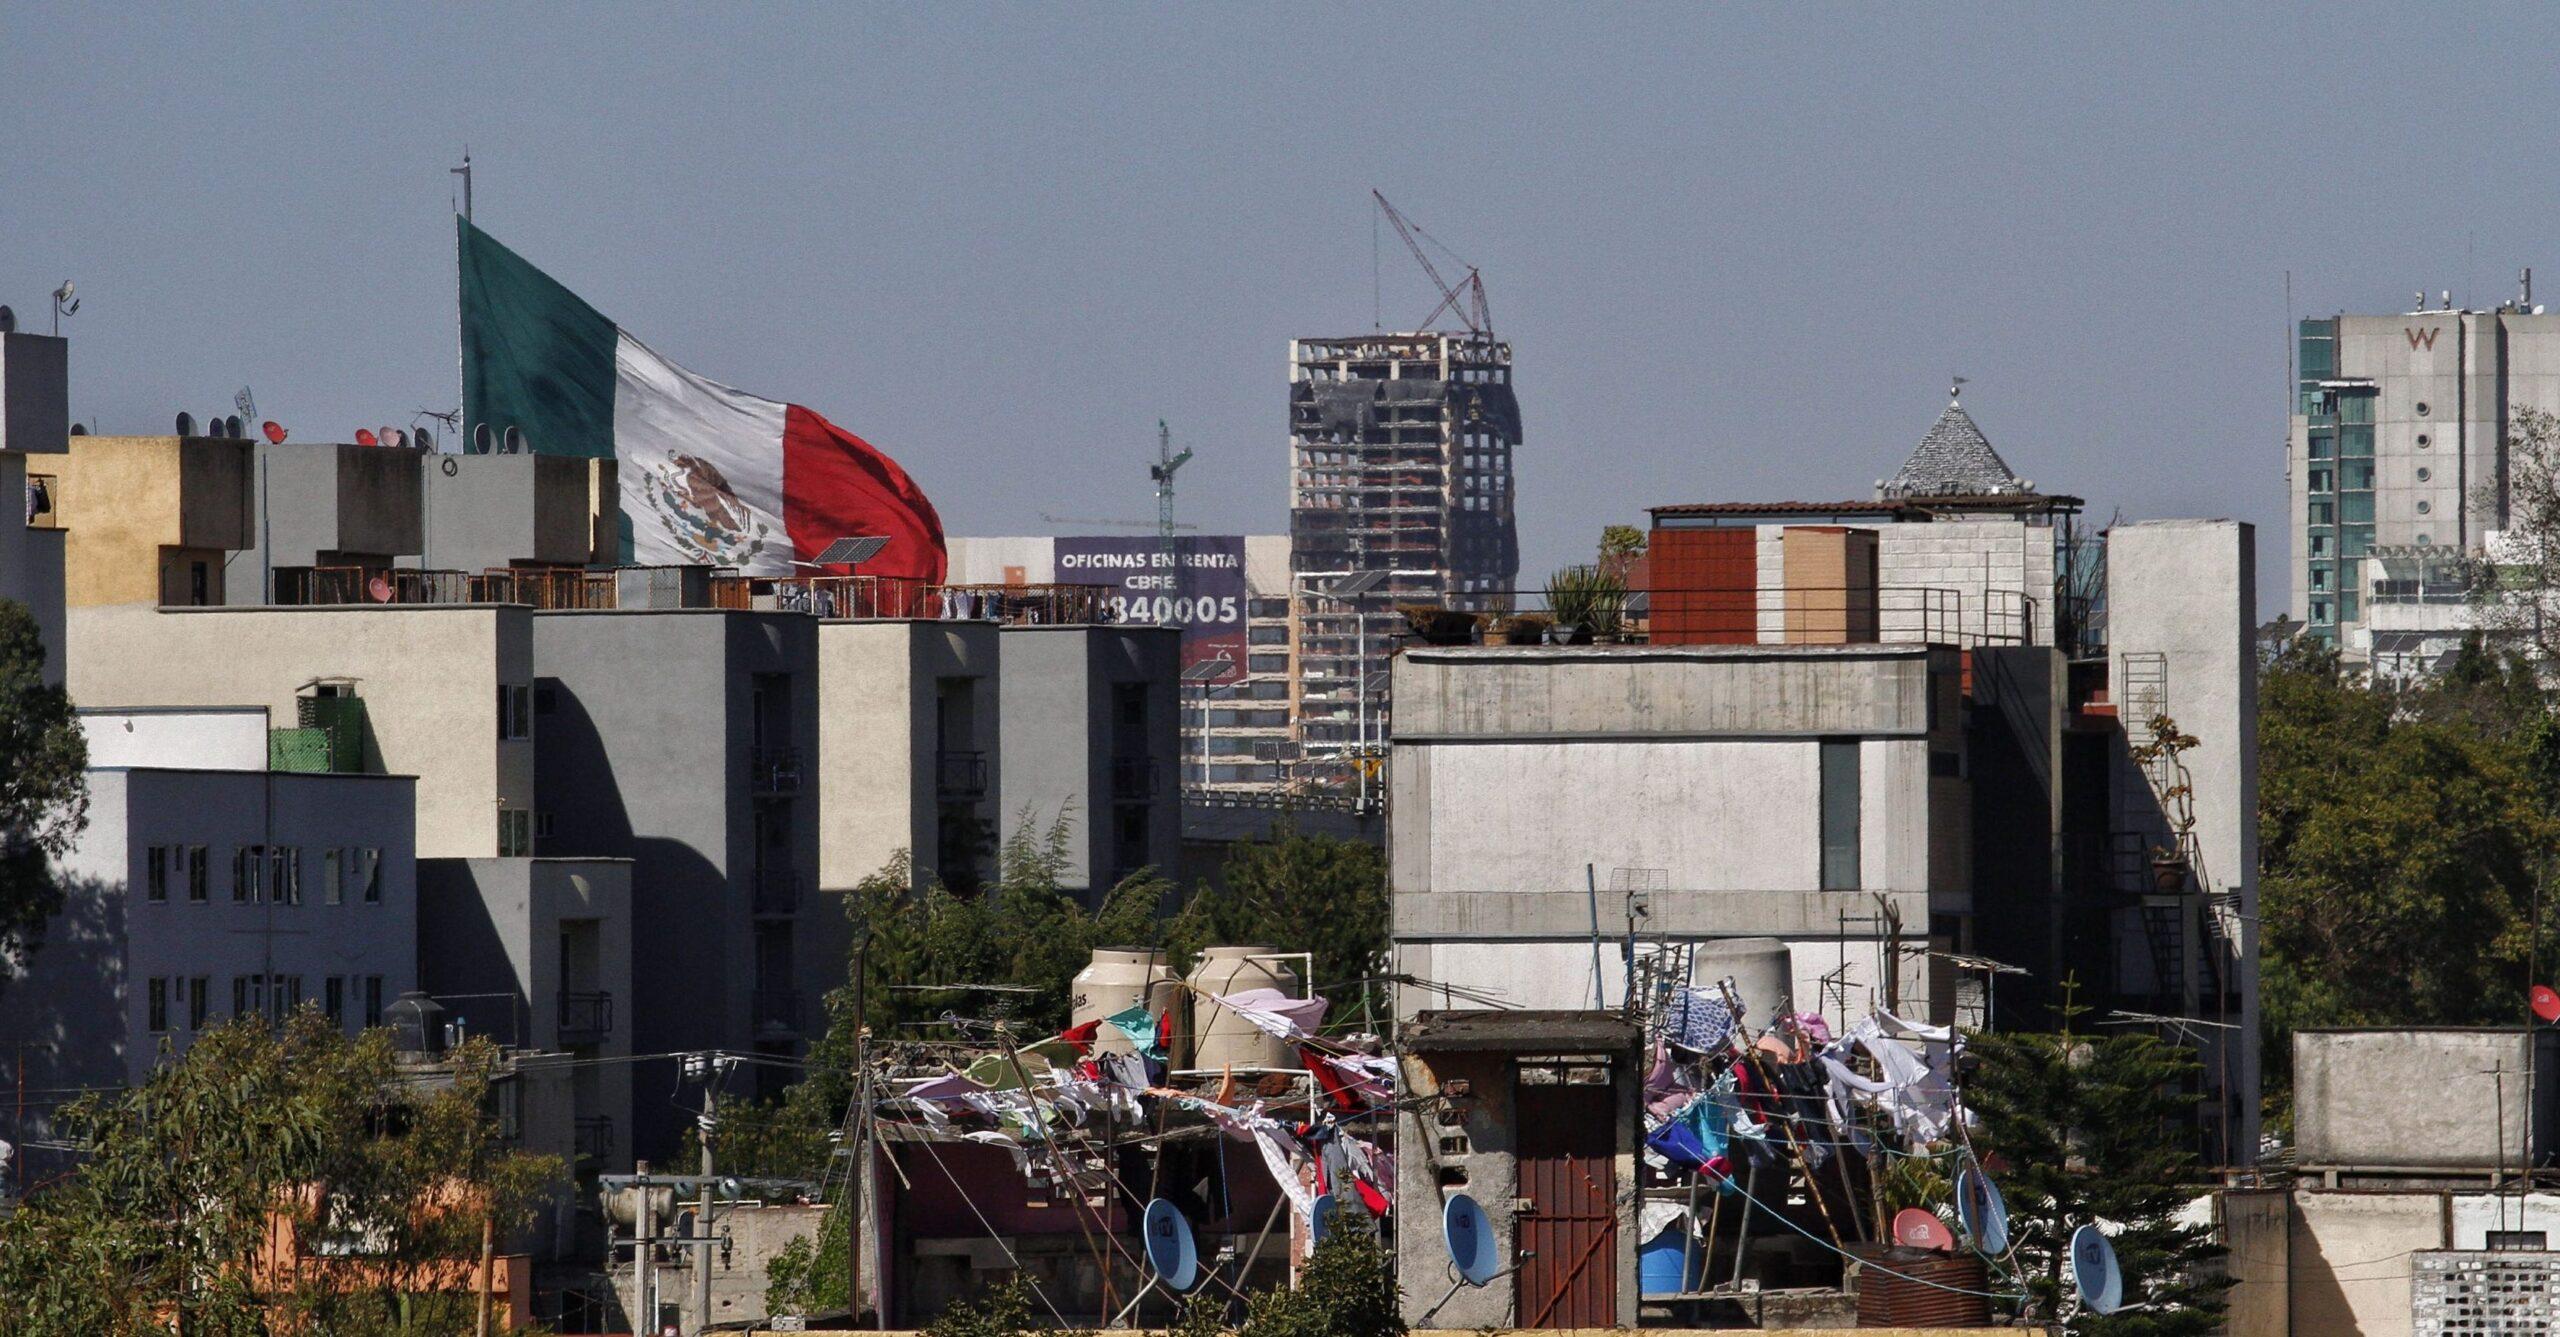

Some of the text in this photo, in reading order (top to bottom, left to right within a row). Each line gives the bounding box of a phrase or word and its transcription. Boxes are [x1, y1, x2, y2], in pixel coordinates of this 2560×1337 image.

[2405, 327, 2440, 351] W
[1062, 553, 1238, 569] OFICINAS EN RENTA
